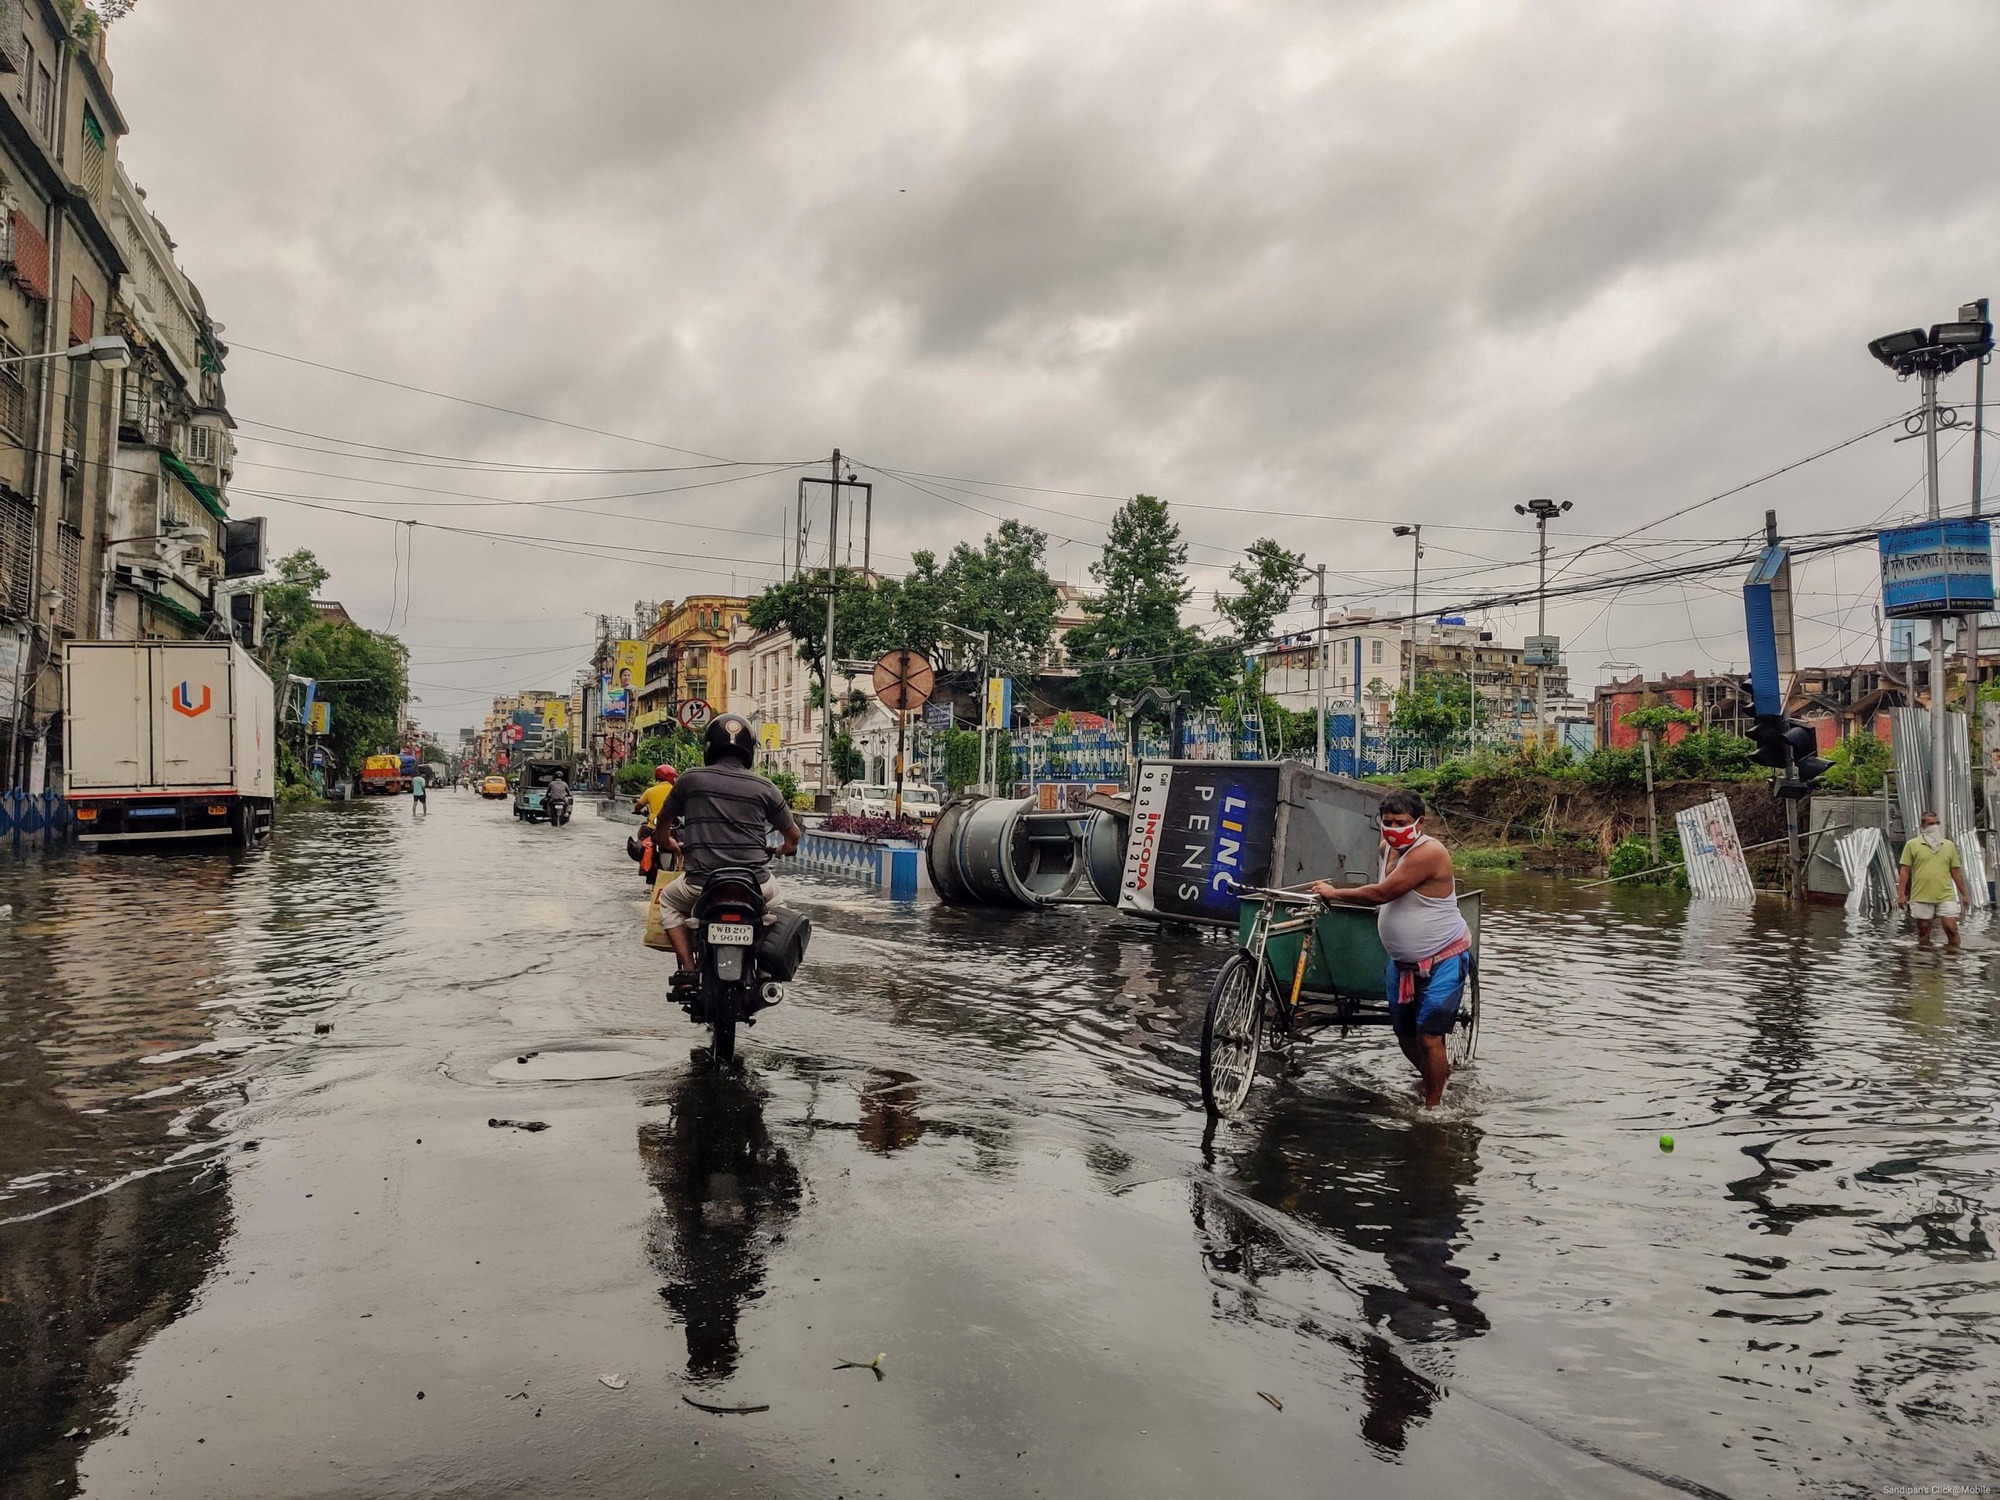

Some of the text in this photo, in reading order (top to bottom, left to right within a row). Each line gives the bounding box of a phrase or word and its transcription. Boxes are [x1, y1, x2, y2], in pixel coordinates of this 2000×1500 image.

[1160, 773, 1169, 786] Call
[1178, 786, 1215, 900] PENS
[1212, 796, 1246, 895] LINC
